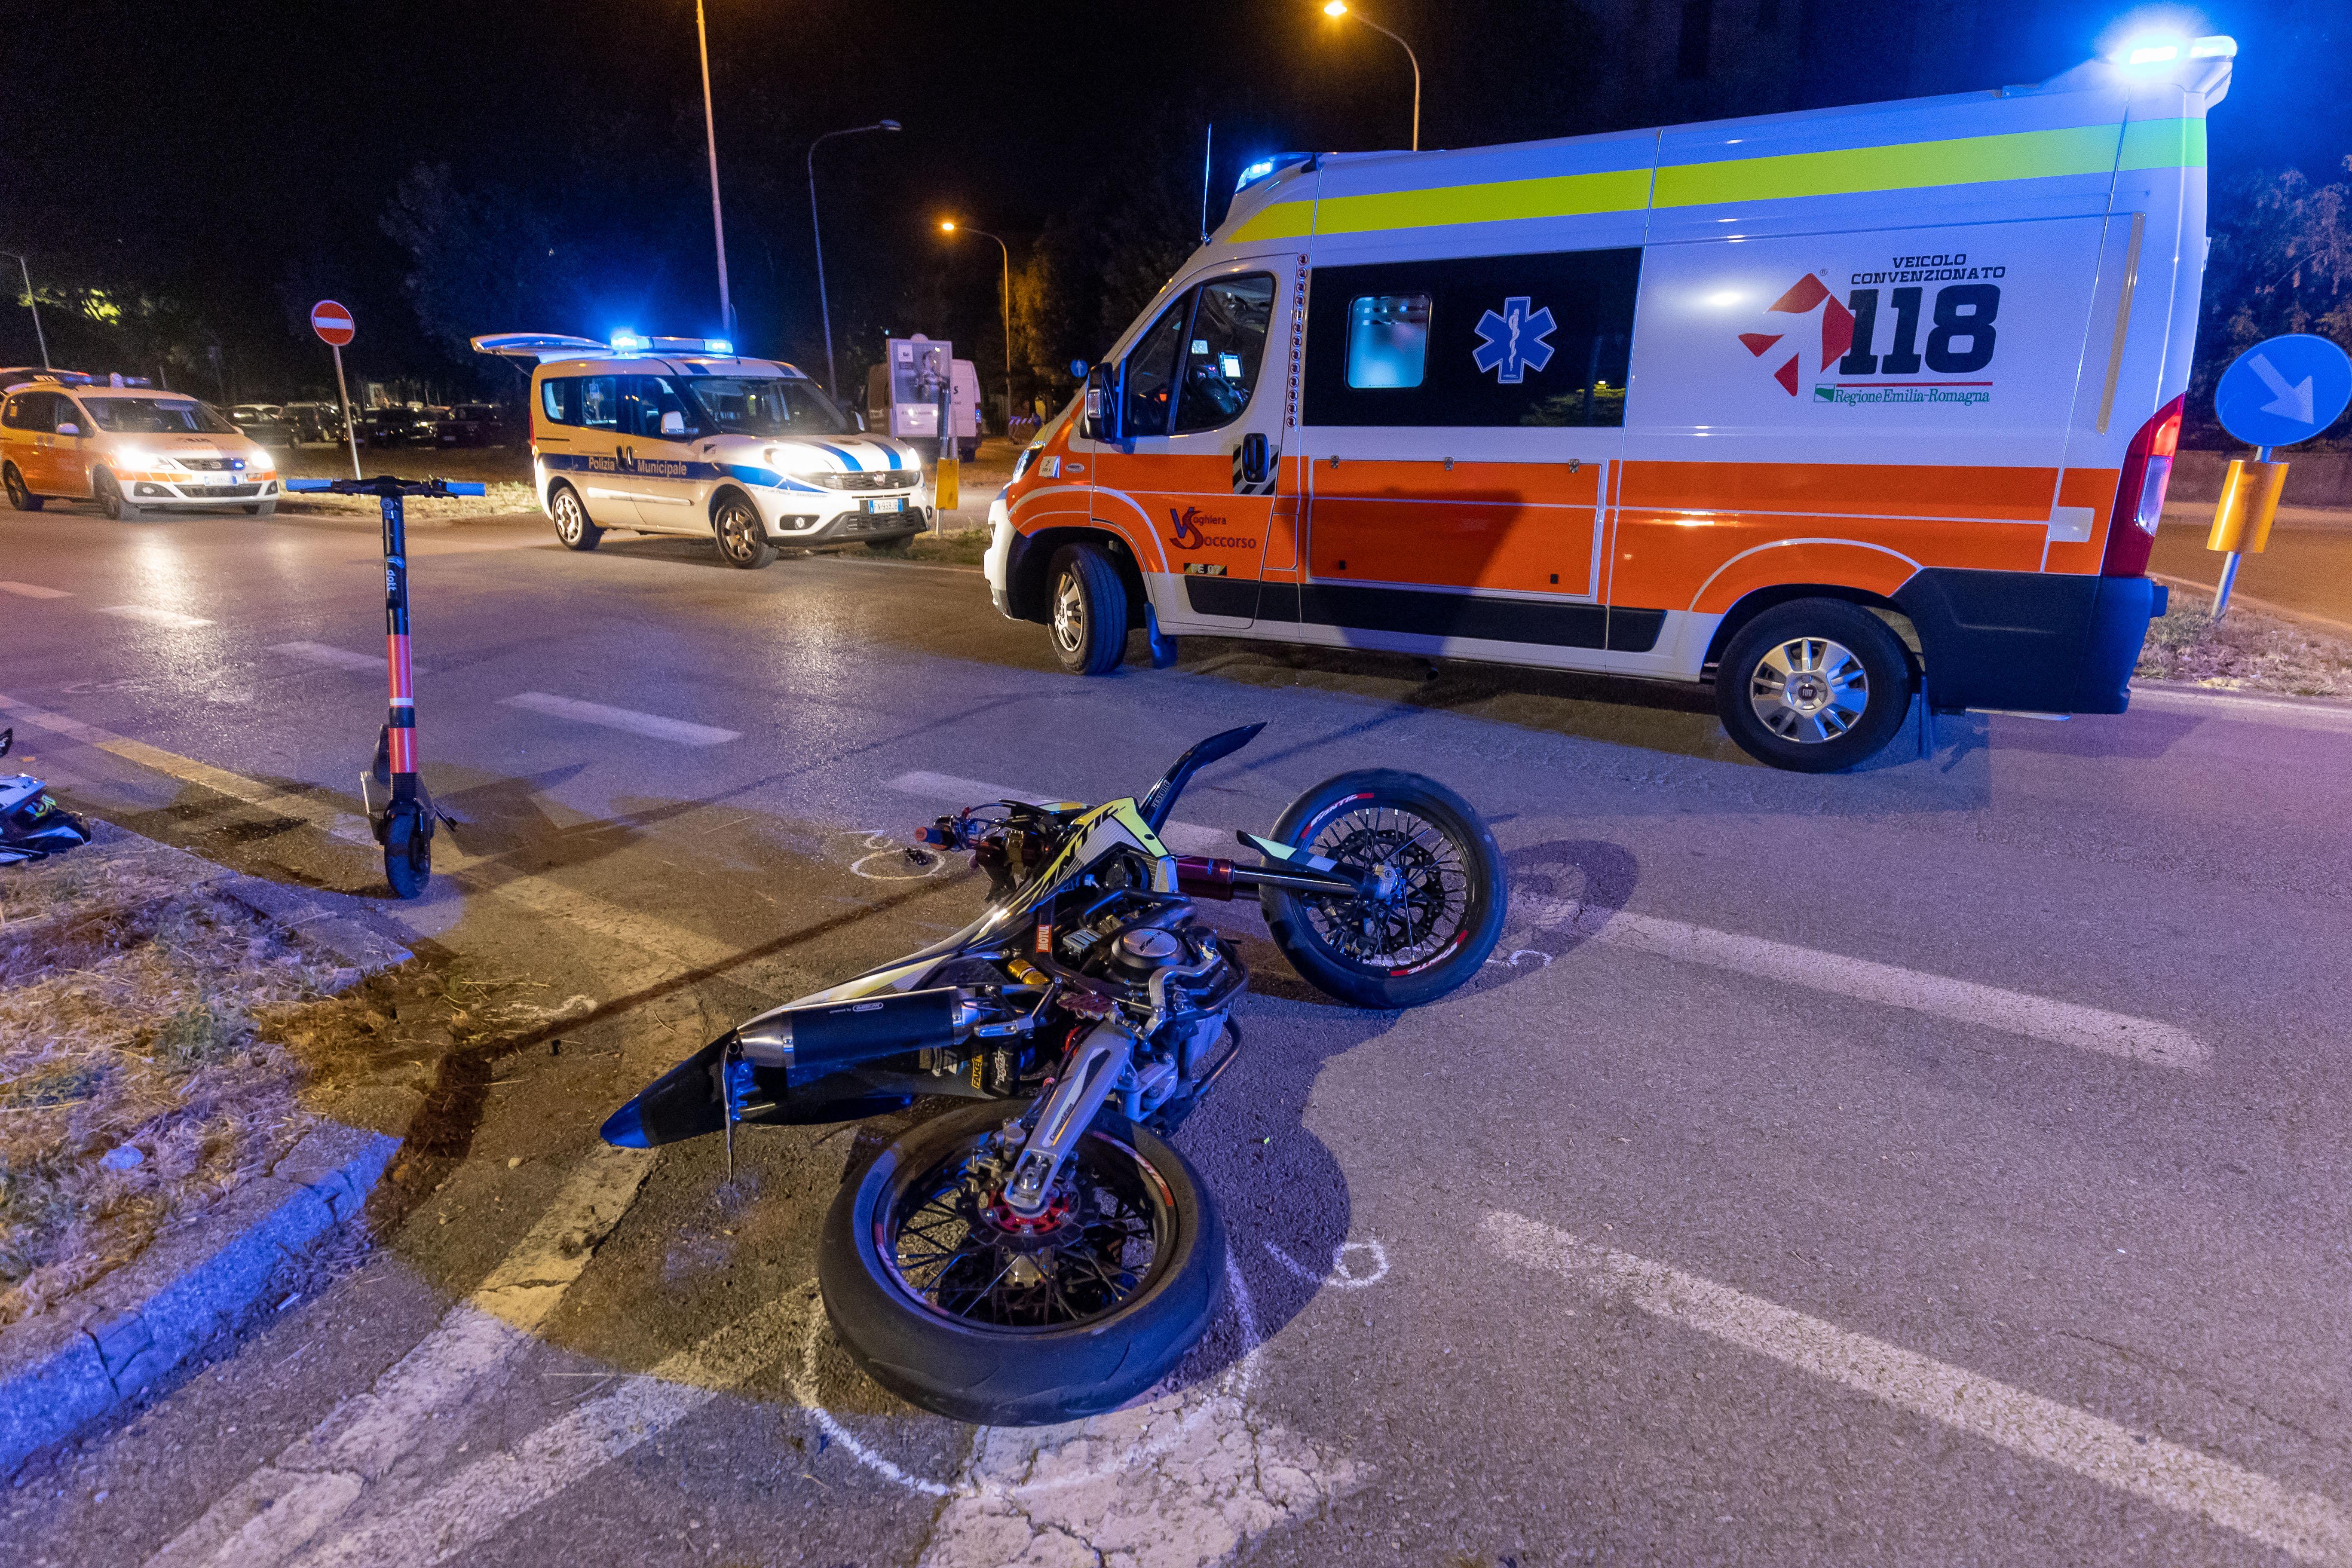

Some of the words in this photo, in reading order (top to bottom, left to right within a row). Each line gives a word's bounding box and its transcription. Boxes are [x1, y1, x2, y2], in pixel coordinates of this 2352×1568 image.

[1893, 254, 1966, 269] VEICOLO
[1851, 266, 2006, 285] CONVENZIONATO
[1839, 284, 2001, 375] 118
[588, 456, 615, 471] Polizia
[637, 459, 687, 478] Municipale
[386, 570, 396, 592] dott
[1802, 689, 1813, 697] FIAT
[1038, 925, 1050, 951] MOTUL
